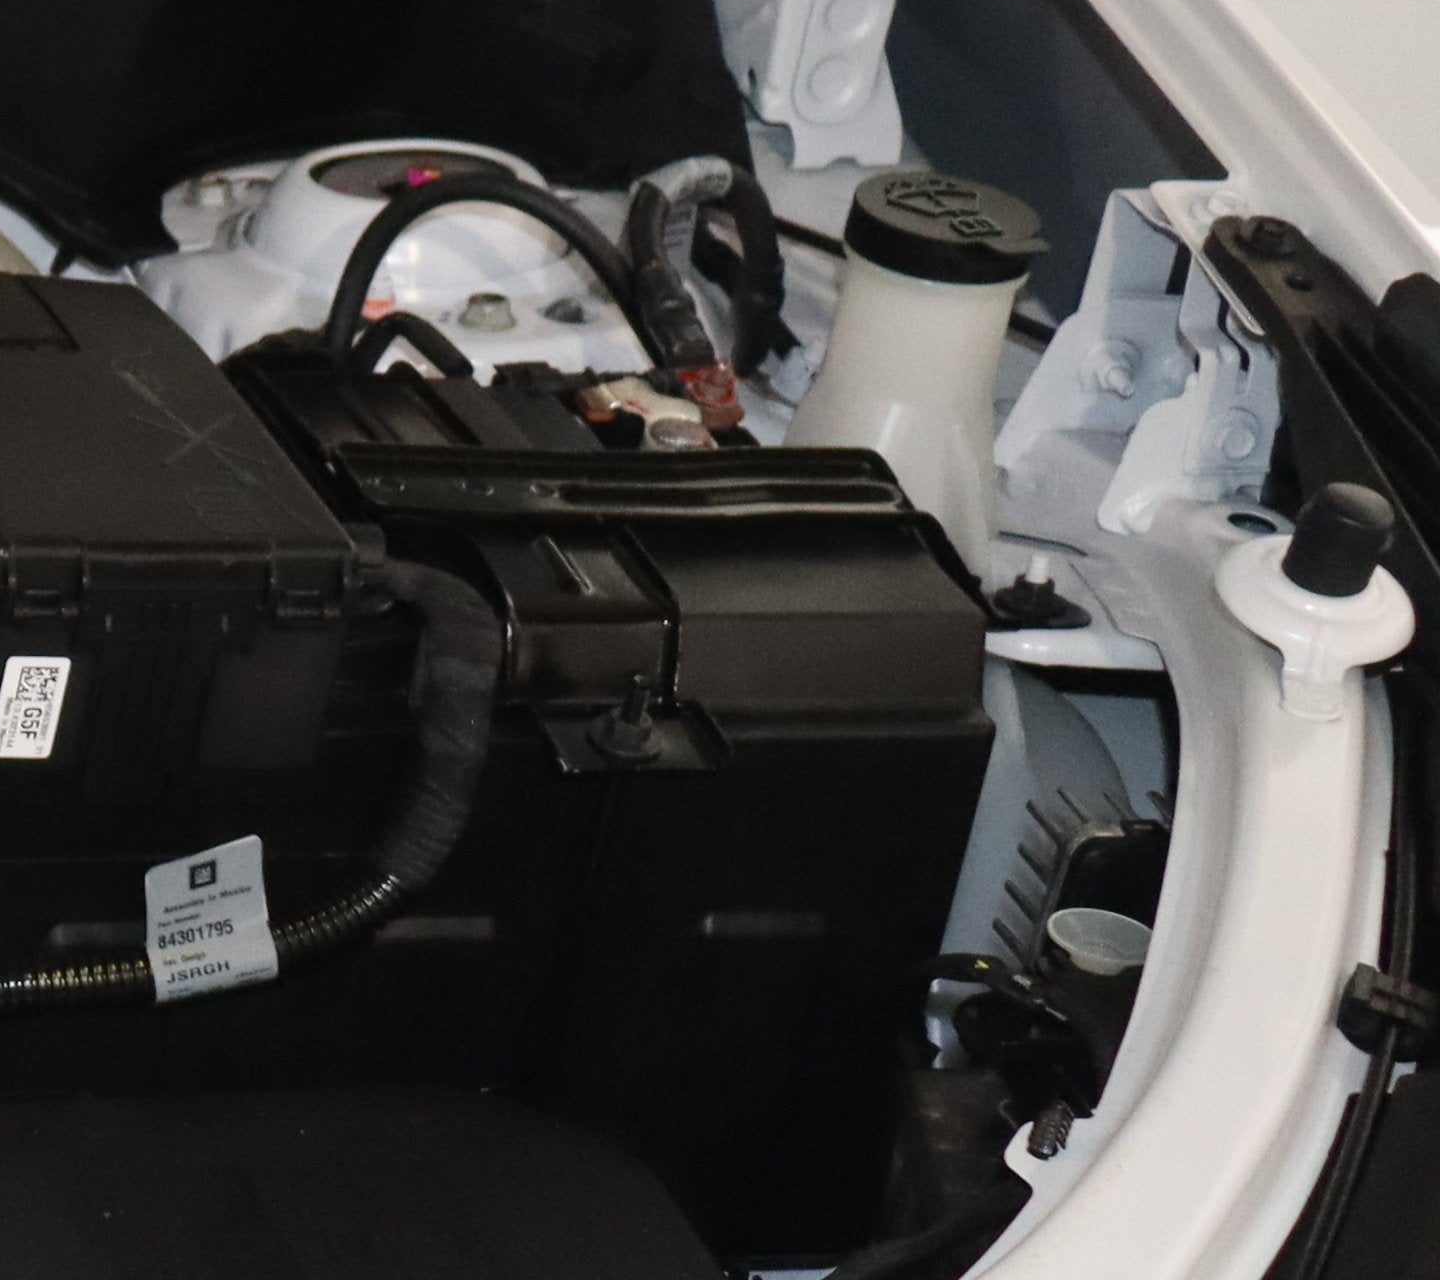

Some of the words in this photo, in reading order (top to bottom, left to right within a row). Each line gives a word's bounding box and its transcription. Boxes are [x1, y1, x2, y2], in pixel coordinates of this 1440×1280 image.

[19, 706, 43, 740] G5F
[158, 919, 234, 949] 84301795
[166, 960, 231, 984] JSRGH
